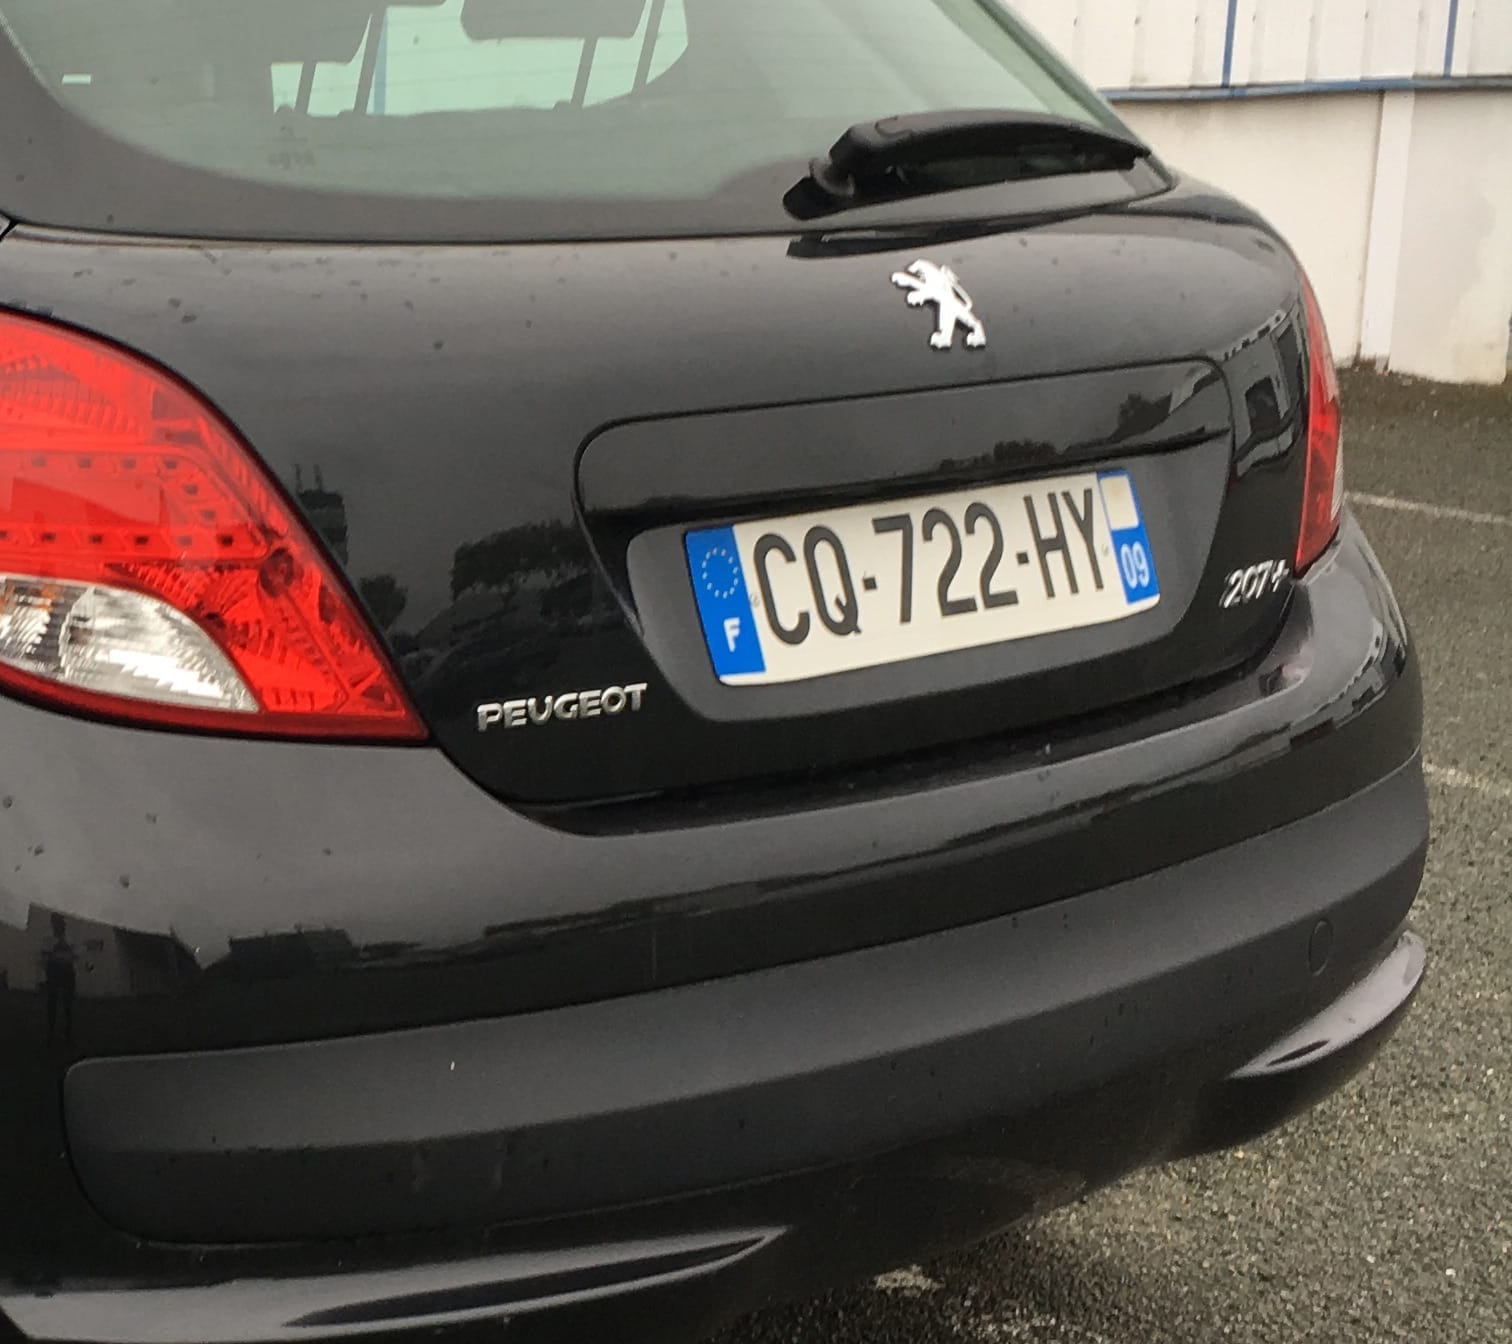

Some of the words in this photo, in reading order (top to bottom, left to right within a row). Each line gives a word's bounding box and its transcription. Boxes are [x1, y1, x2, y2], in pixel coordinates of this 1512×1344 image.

[724, 617, 740, 653] F
[754, 488, 1104, 645] CQ-722-HY
[1120, 540, 1150, 590] 09
[477, 682, 648, 732] PEUGEOT
